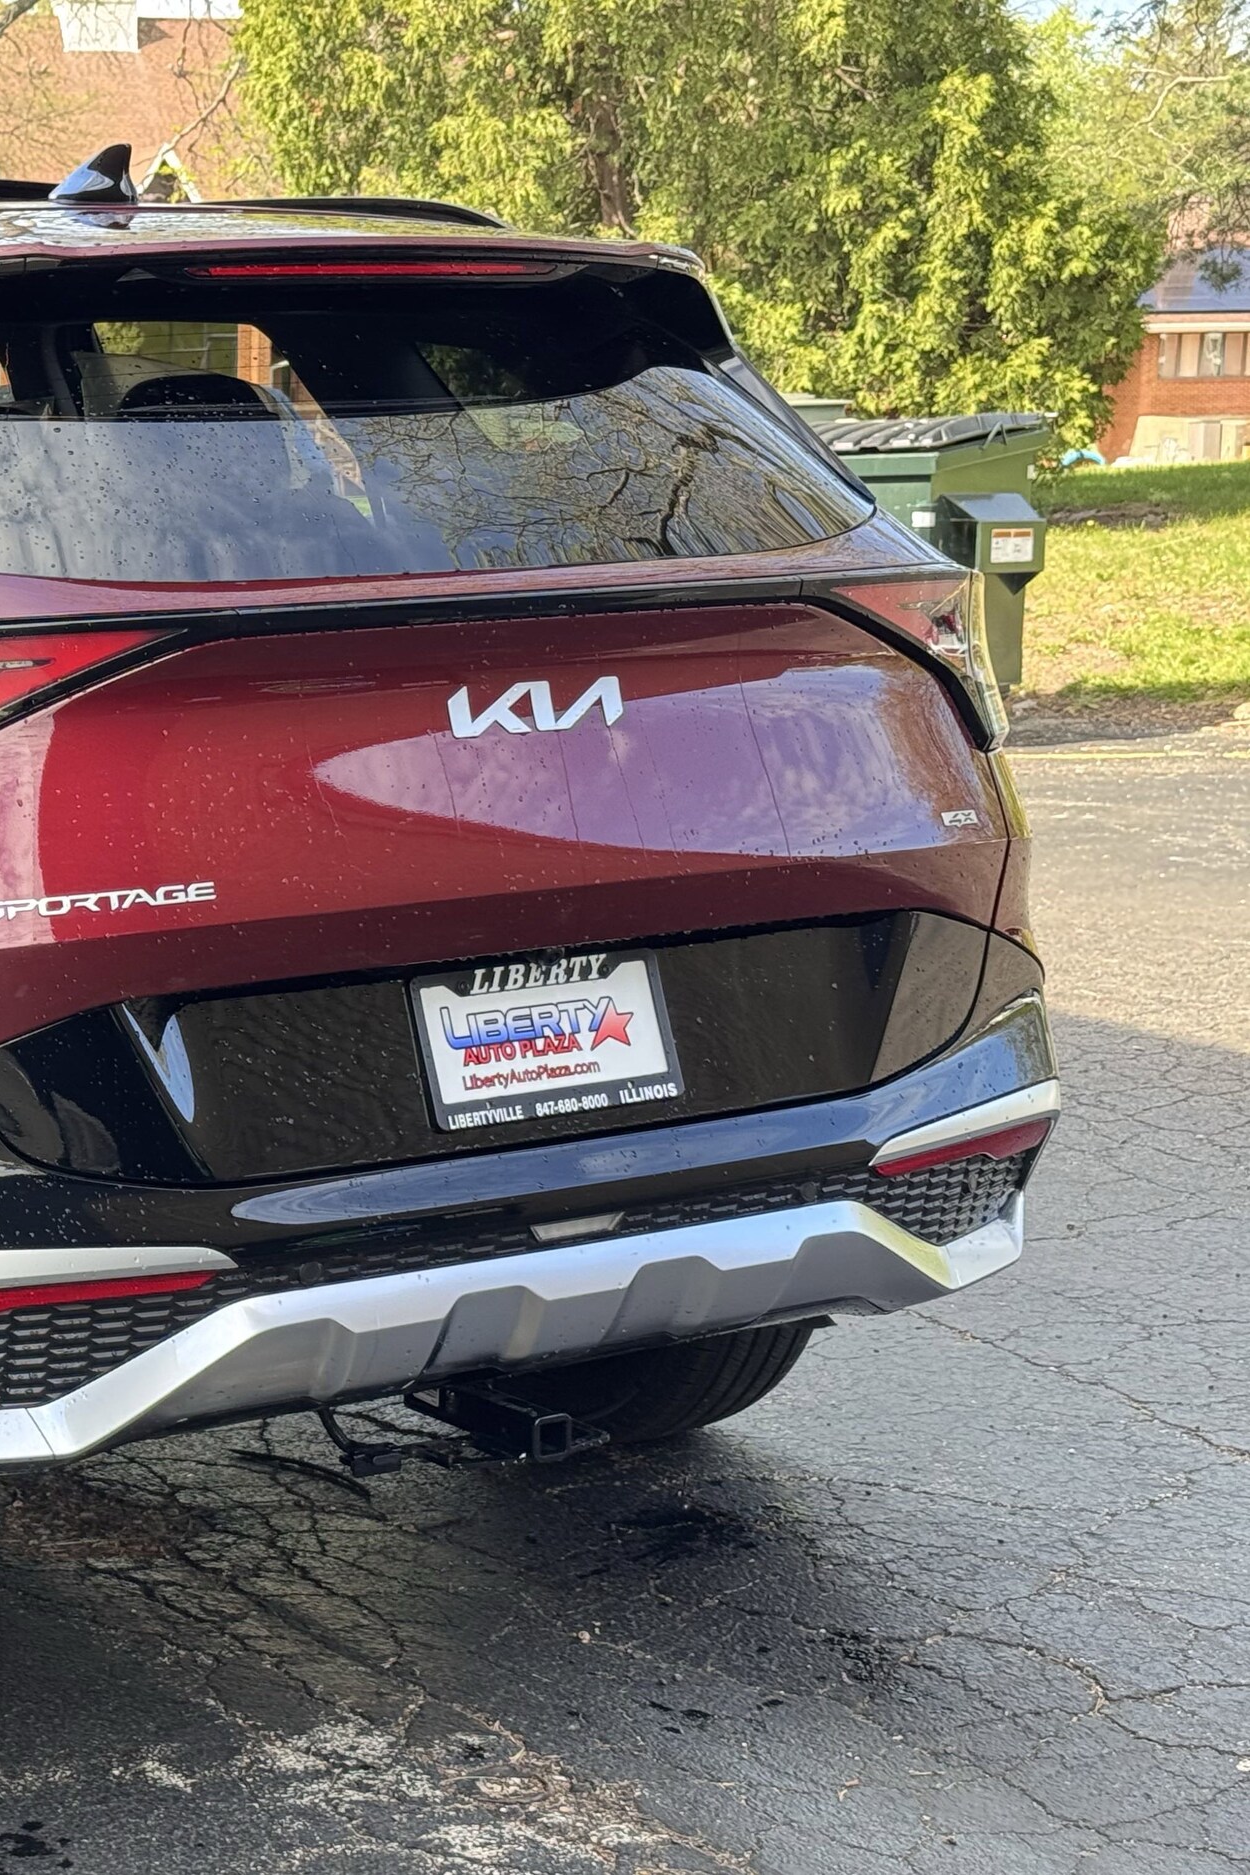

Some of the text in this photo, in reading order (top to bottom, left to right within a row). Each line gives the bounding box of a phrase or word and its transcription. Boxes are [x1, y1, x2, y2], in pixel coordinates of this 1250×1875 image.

[470, 953, 607, 995] LIBERTY
[439, 996, 613, 1050] LIBERTY
[462, 1034, 581, 1067] AUTO PLAZA
[447, 1082, 679, 1130] LIBERTYVILLE 847-680-8000 ILLINOIS
